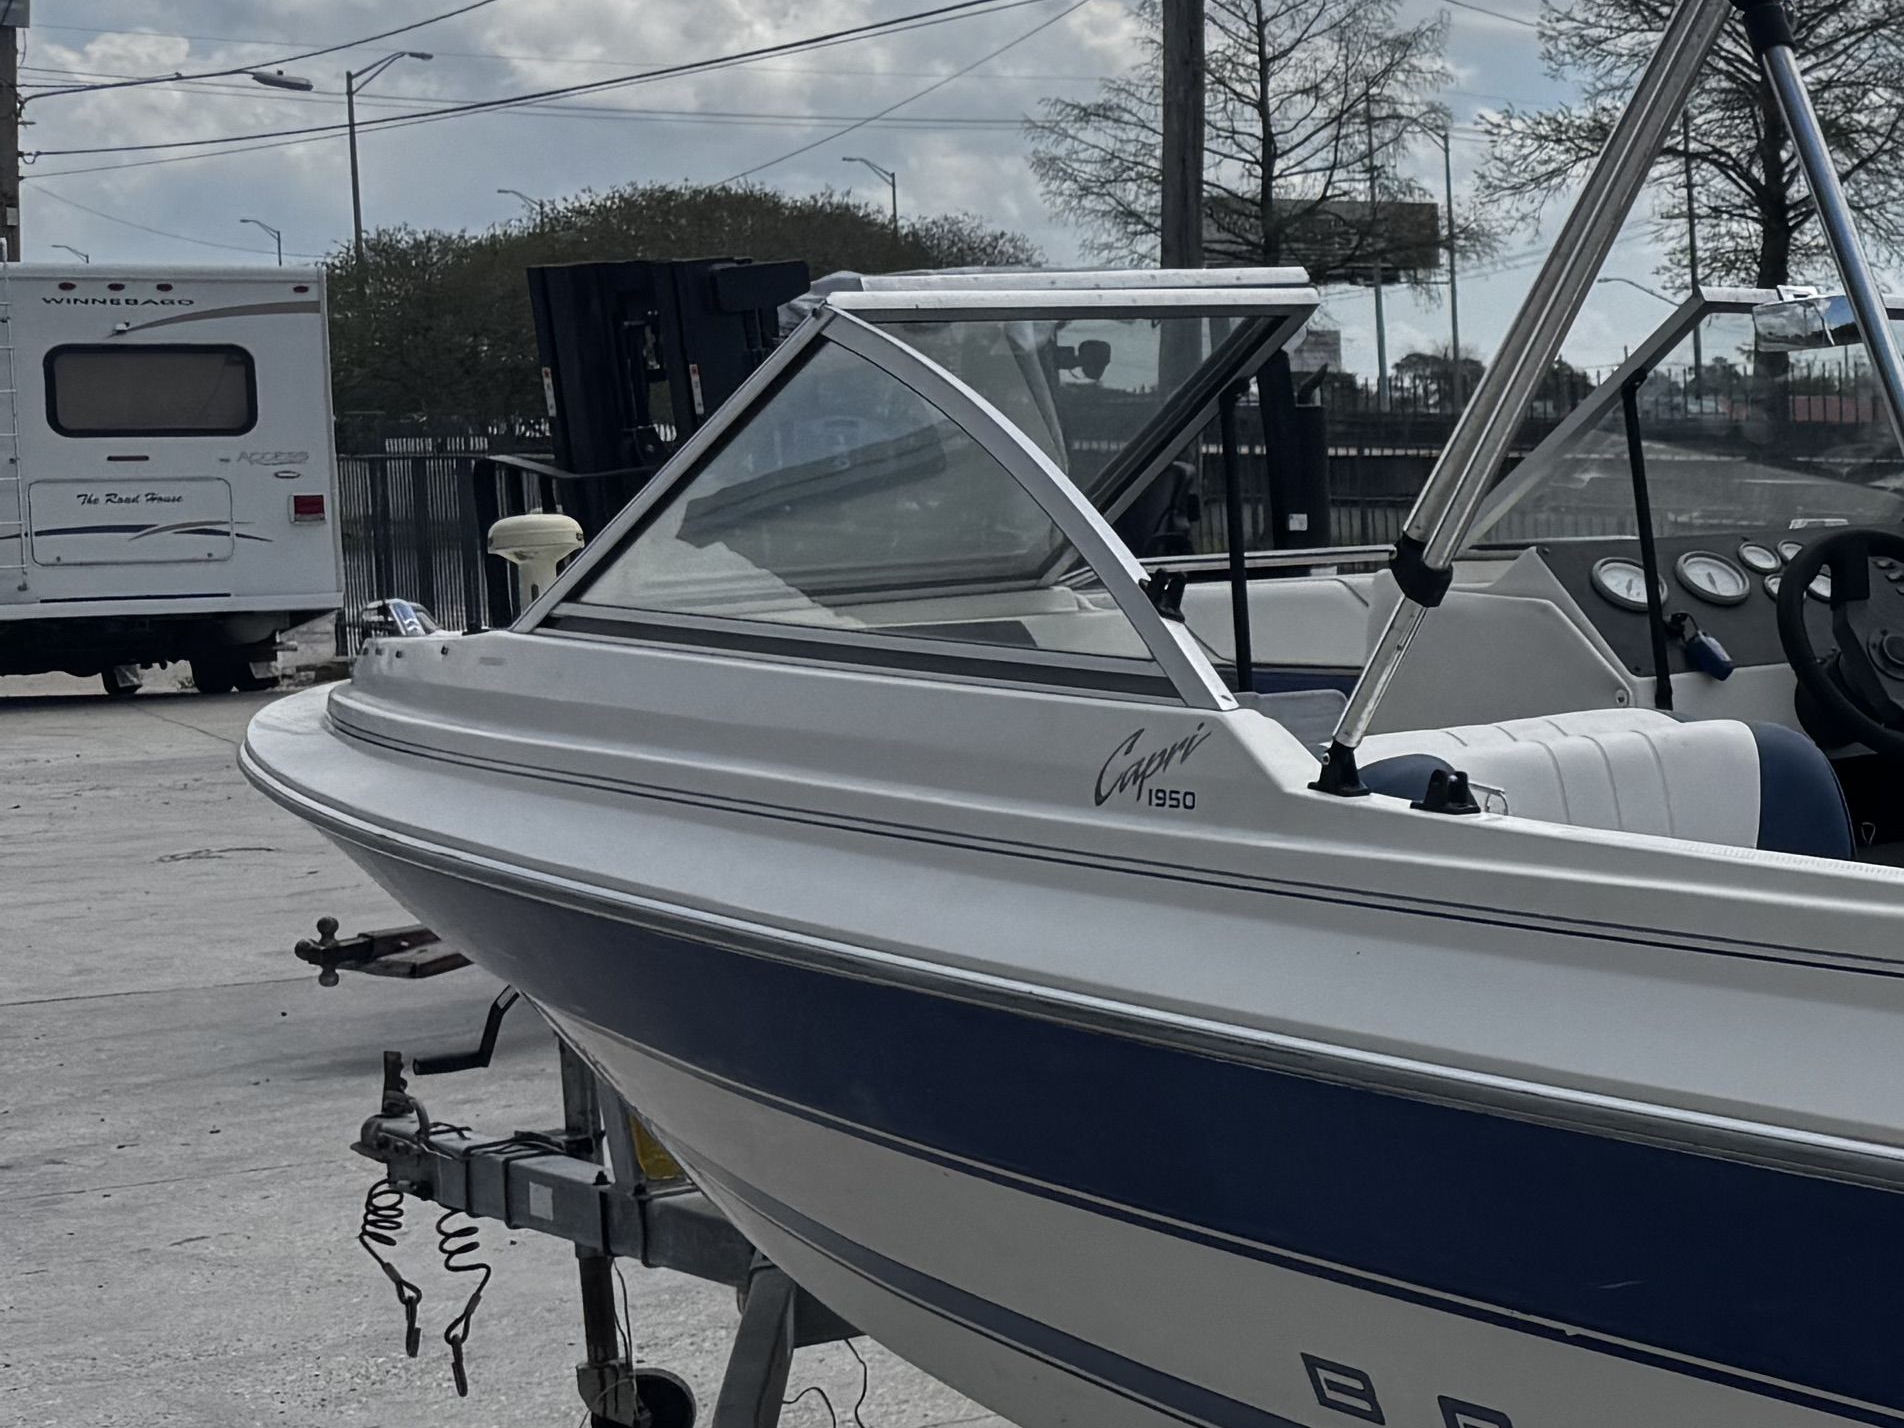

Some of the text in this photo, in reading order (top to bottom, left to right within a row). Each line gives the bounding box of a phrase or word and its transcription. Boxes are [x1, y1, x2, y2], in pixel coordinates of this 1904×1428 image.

[41, 297, 195, 306] WINNEBAGO
[77, 492, 184, 505] The Road House
[1095, 722, 1213, 807] Capri
[1148, 788, 1196, 810] 1950
